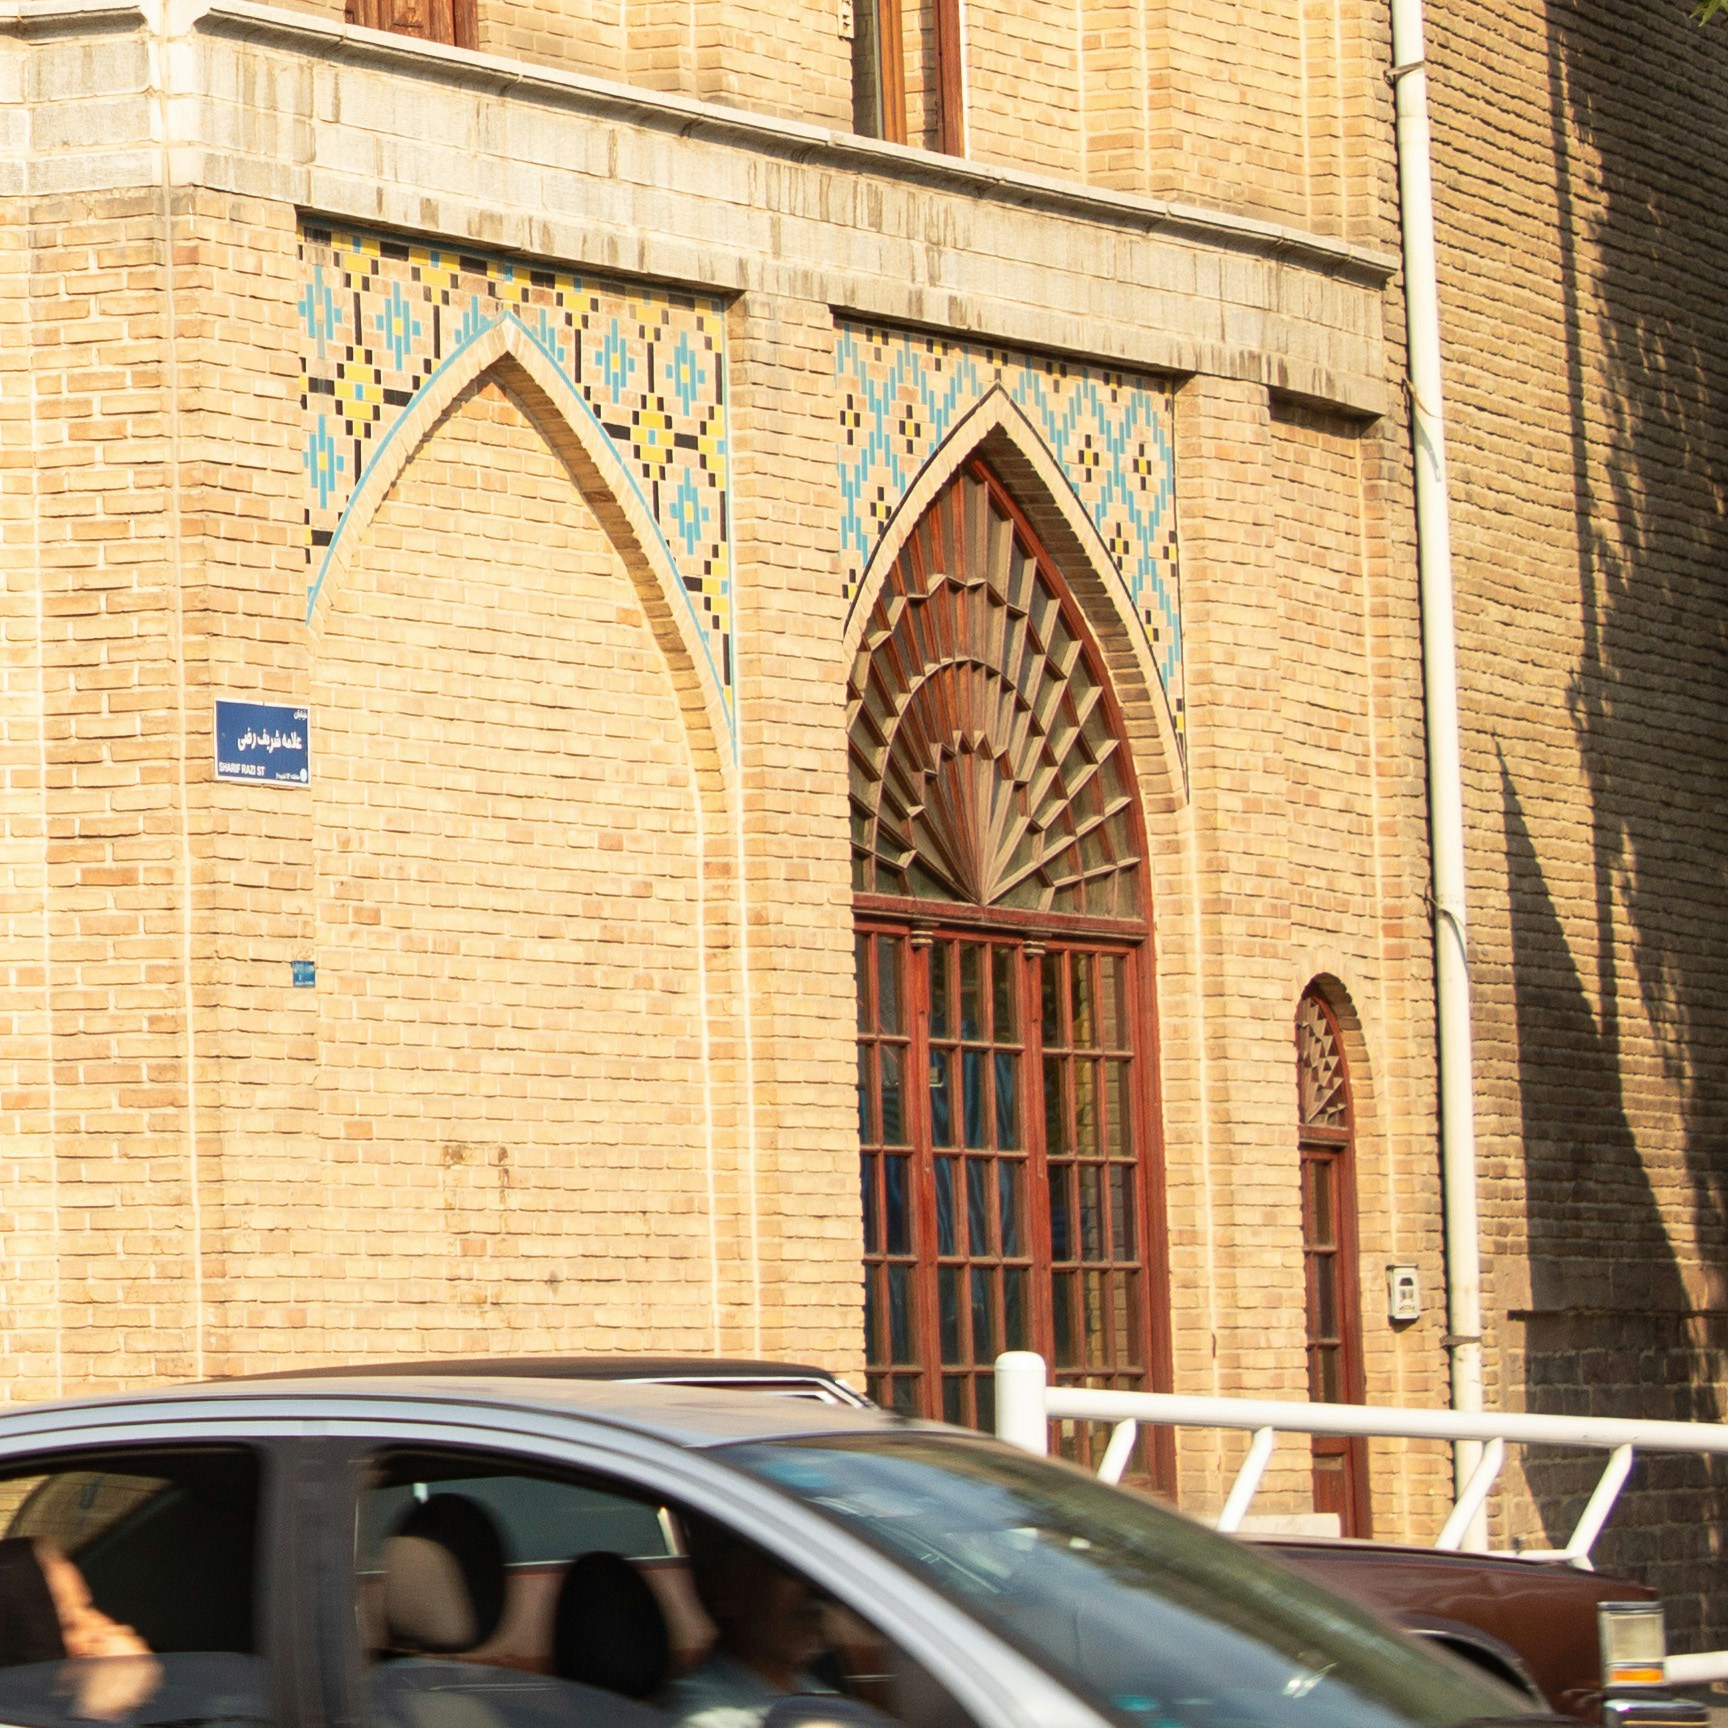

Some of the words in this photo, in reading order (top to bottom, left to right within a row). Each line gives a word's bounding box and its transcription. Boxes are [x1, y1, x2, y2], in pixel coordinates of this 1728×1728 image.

[237, 727, 257, 752] رضی
[257, 728, 282, 754] شریف
[282, 731, 302, 750] علامه
[241, 763, 256, 776] RAZI
